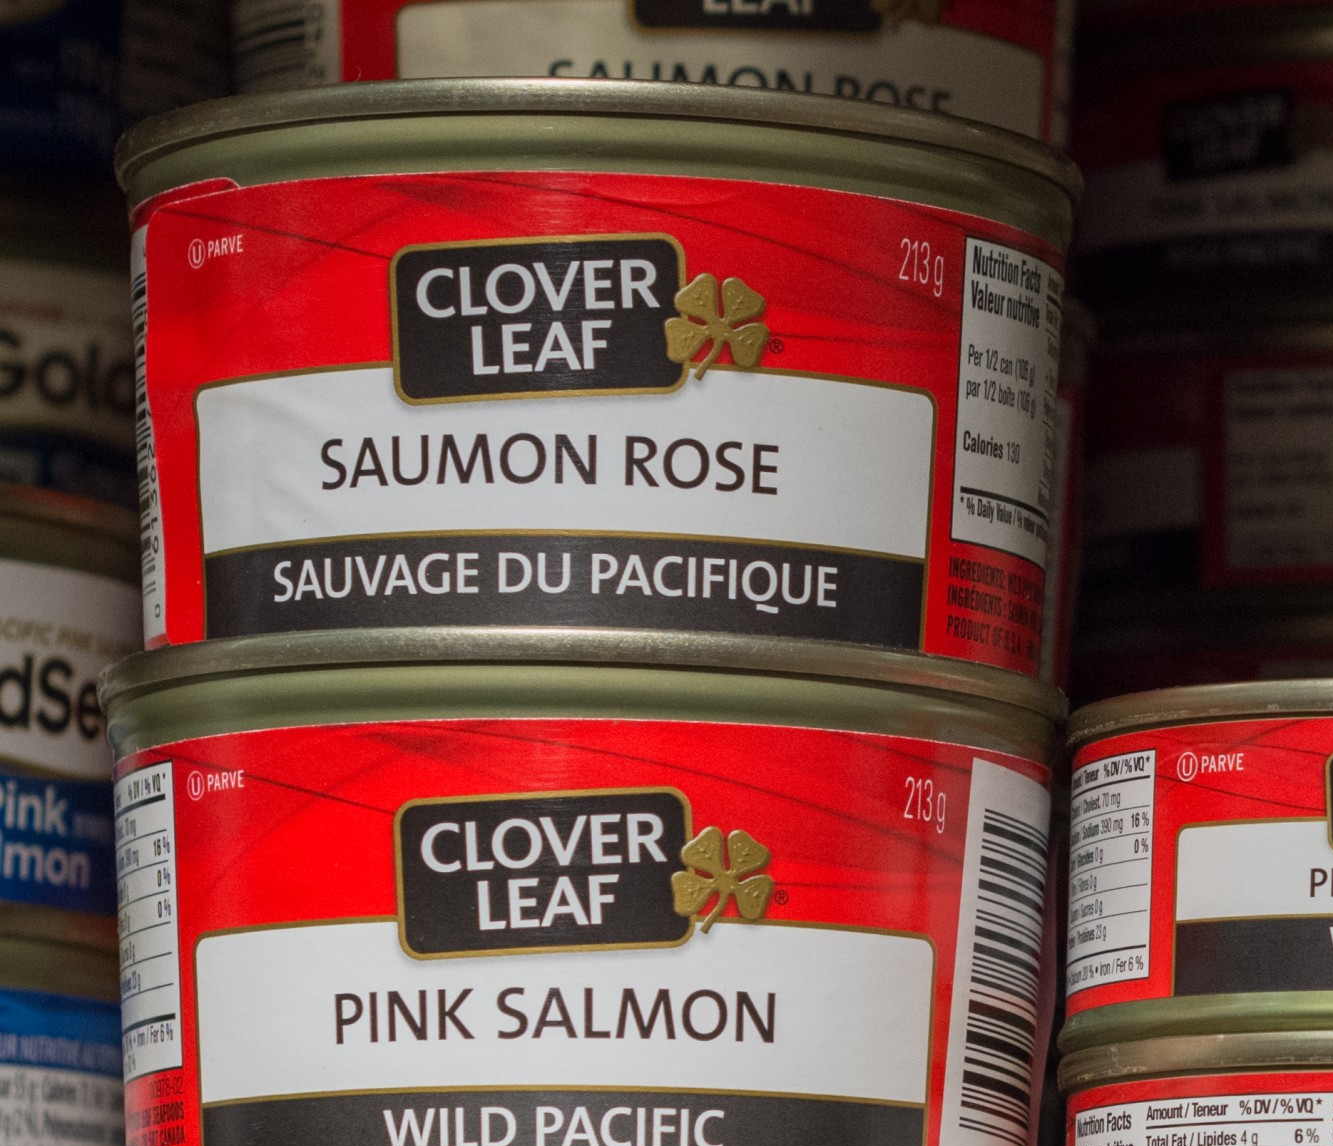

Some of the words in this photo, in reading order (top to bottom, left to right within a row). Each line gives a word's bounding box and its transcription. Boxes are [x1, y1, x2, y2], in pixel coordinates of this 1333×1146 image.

[416, 259, 660, 318] CLOVER
[470, 319, 610, 376] LEAF
[320, 432, 598, 490] SAUMON
[624, 435, 780, 496] ROSE
[273, 553, 480, 602] SAUVAGE
[498, 552, 571, 595] DU
[591, 553, 838, 615] PACIFIQUE
[421, 813, 667, 872] CLOVER
[477, 875, 620, 931] LEAF
[335, 988, 475, 1045] PINK
[497, 988, 776, 1043] SALMON
